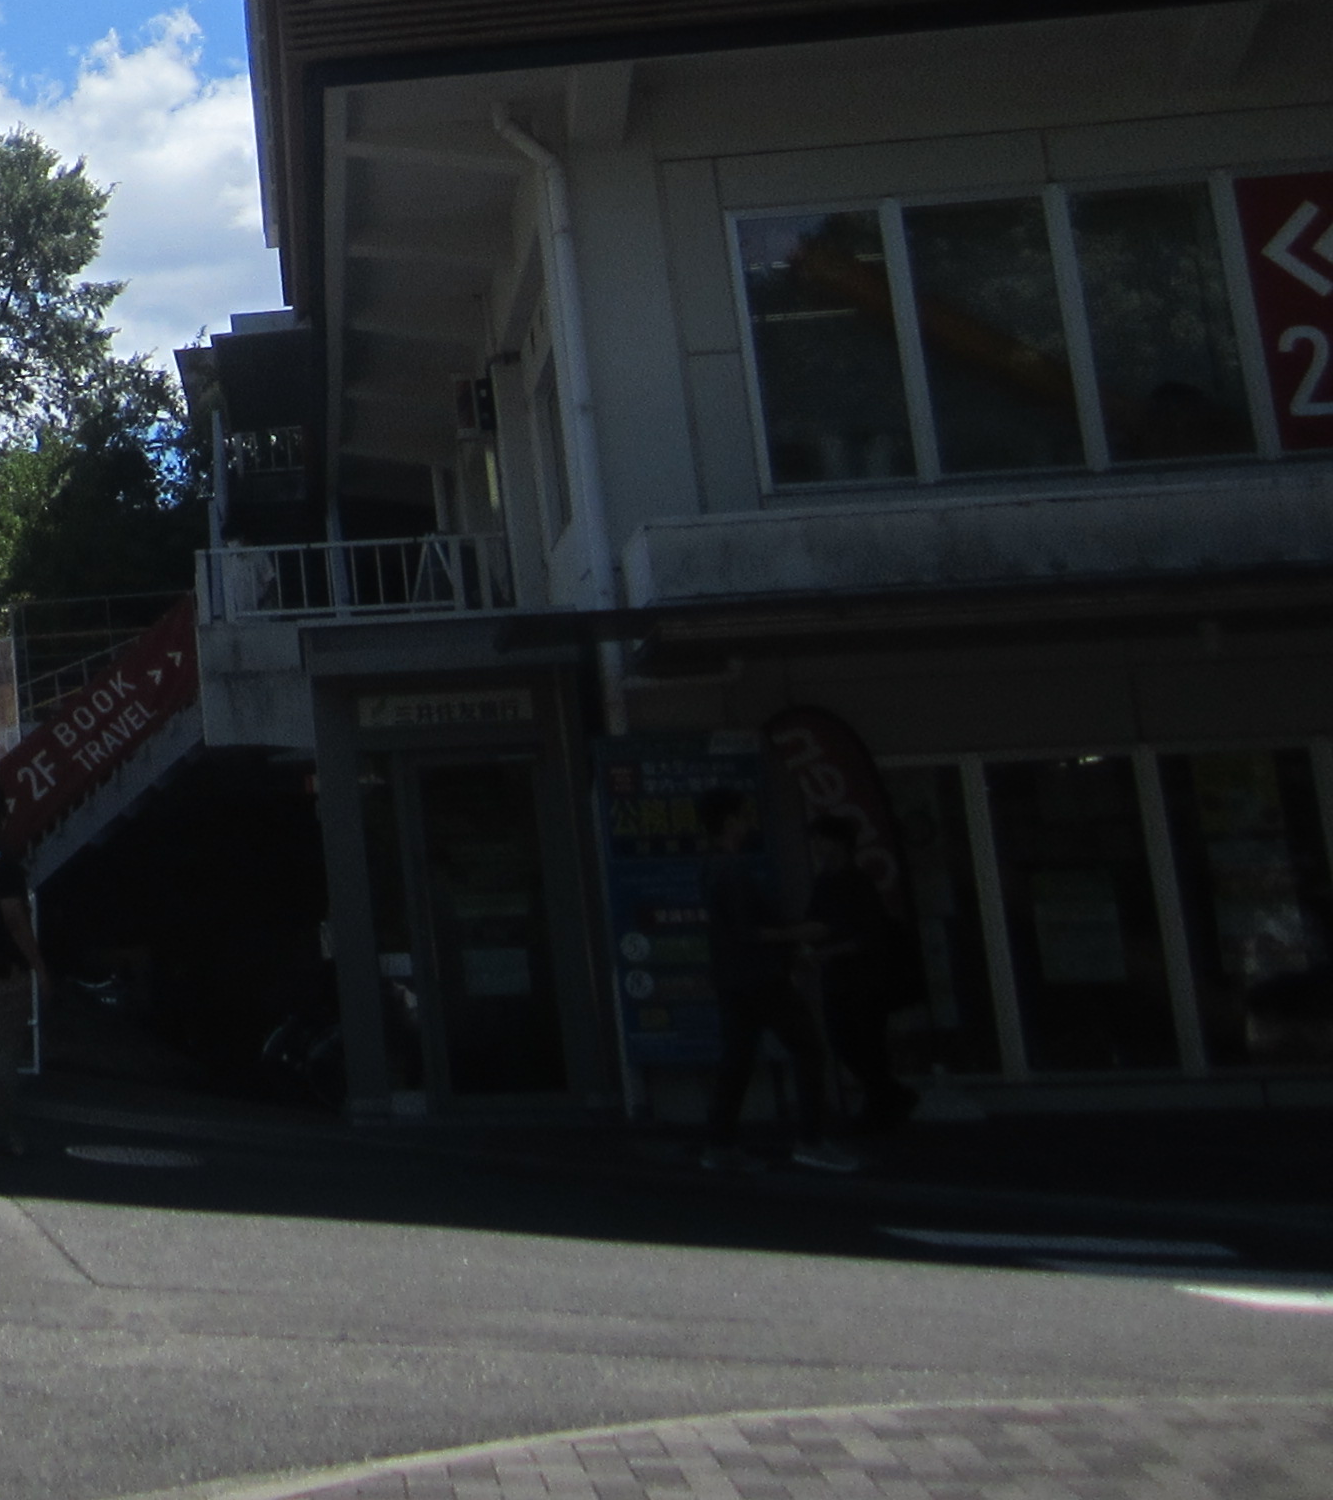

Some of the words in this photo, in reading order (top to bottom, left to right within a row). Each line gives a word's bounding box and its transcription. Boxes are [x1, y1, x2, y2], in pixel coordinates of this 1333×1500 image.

[17, 749, 57, 802] 2F
[71, 700, 158, 773] TRAVEL
[51, 670, 137, 749] BOOK
